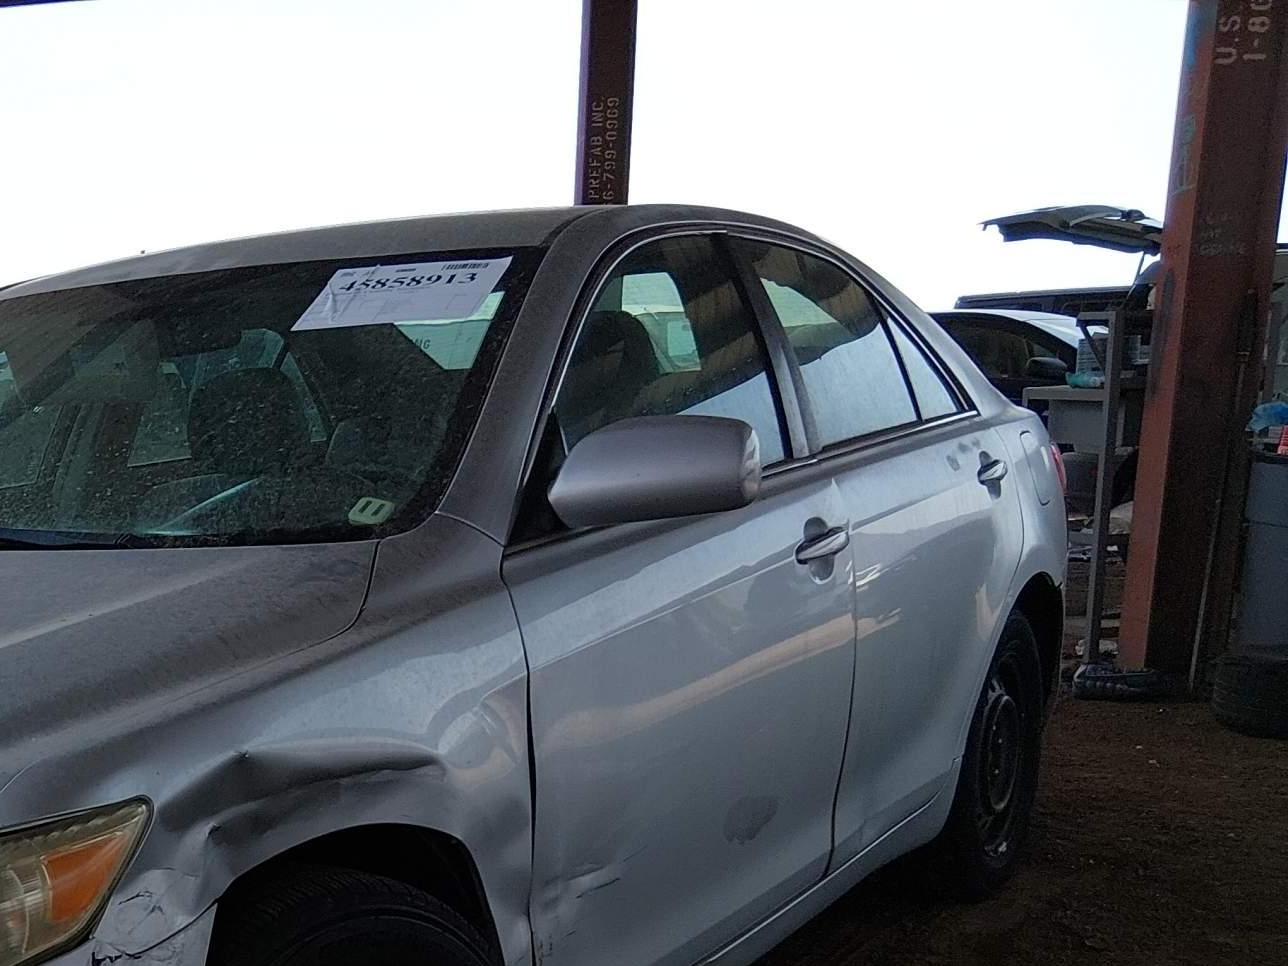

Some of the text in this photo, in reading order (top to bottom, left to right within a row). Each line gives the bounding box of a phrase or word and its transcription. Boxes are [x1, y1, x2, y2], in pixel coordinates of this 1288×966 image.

[588, 135, 603, 199] PREFAB
[602, 97, 620, 204] 6-799-0969
[338, 272, 478, 293] 45858913
